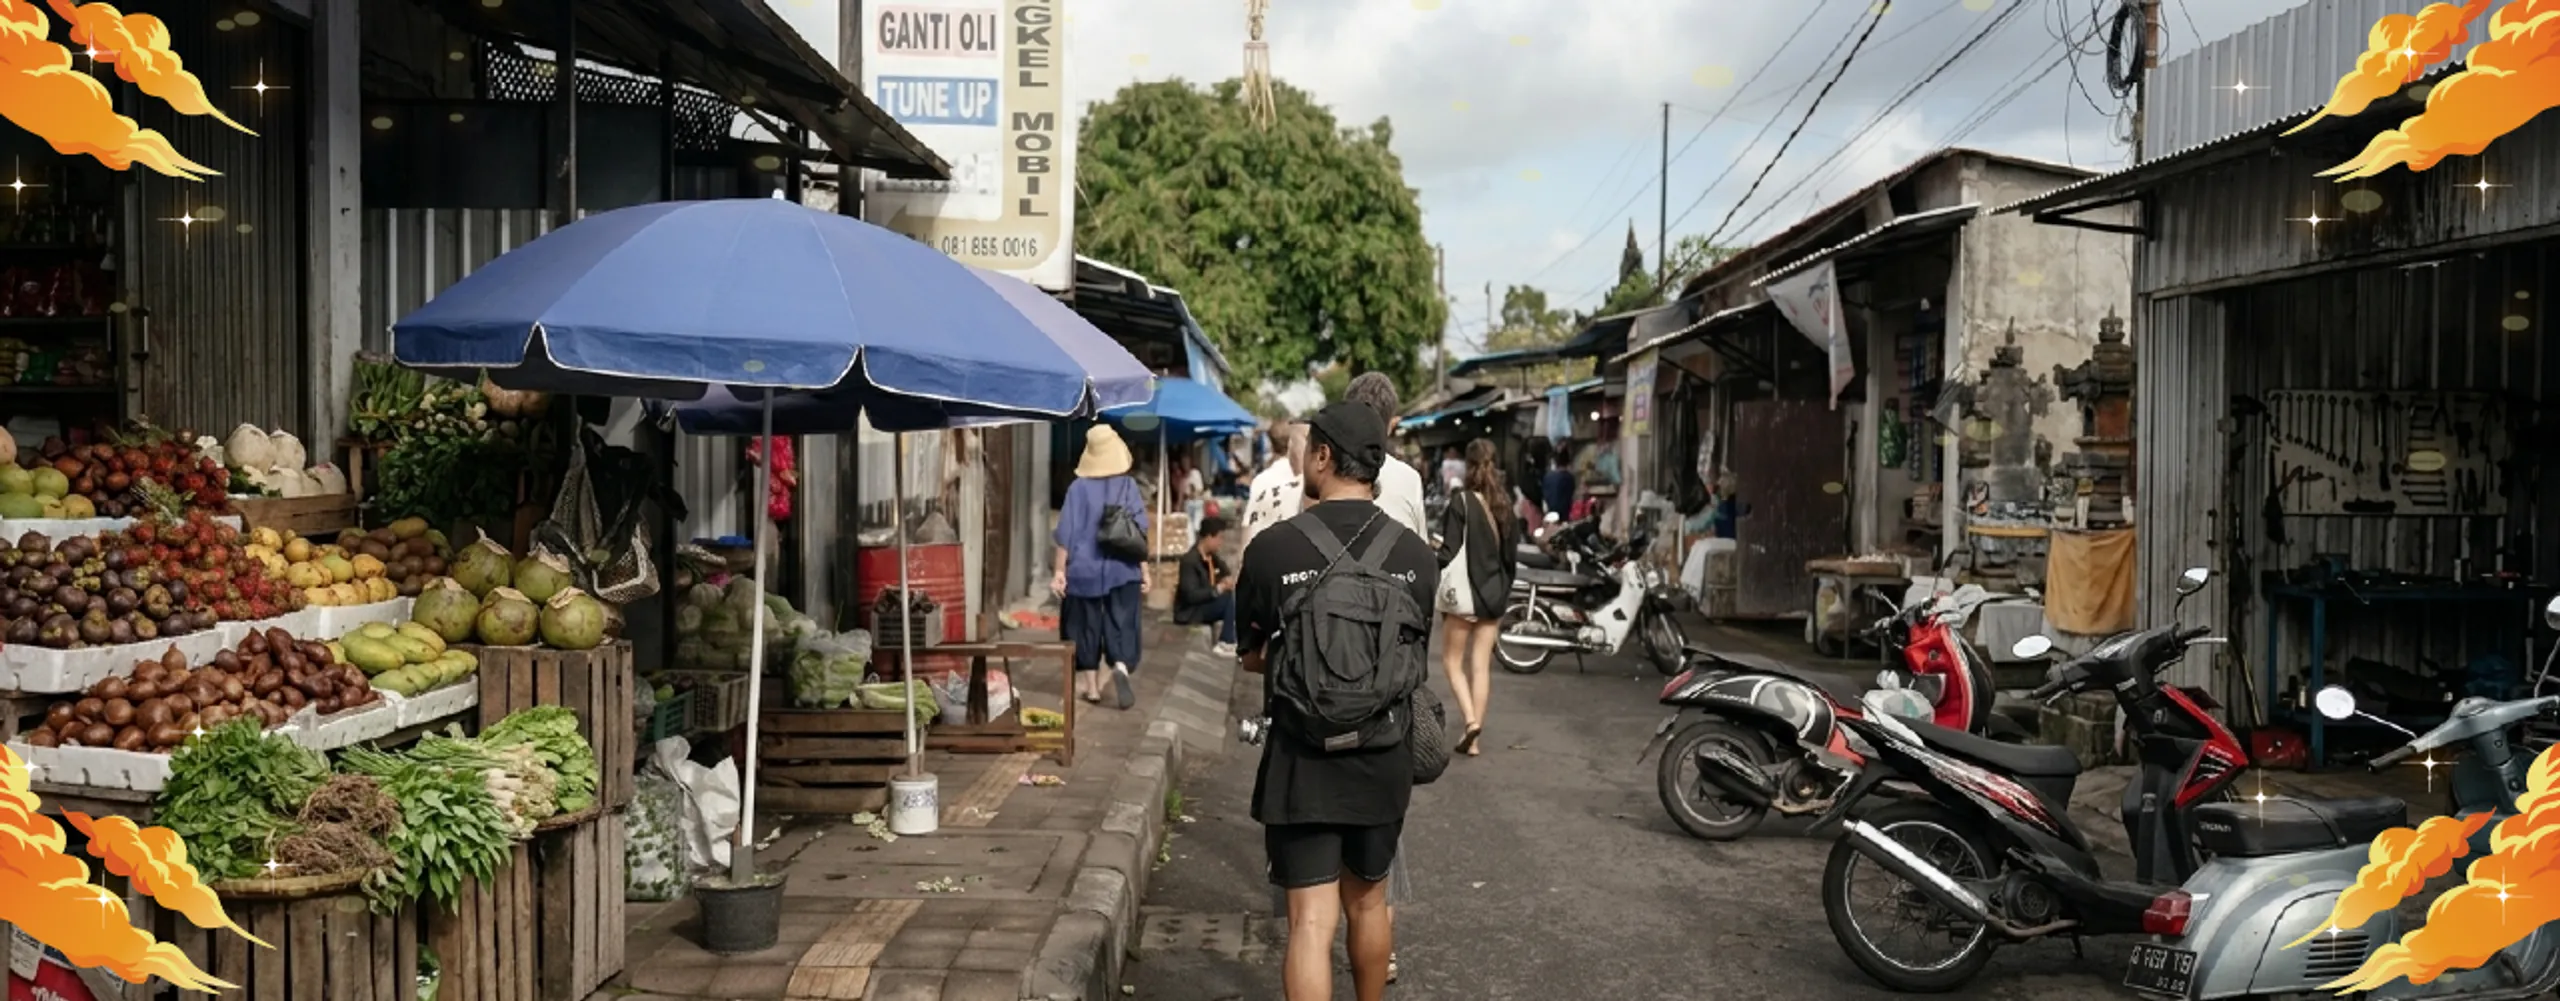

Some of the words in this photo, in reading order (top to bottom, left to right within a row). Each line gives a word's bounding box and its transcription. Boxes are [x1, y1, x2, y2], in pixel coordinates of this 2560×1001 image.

[879, 11, 950, 50] GANTI
[959, 13, 996, 51] OLI
[1014, 0, 1052, 87] GKEL
[881, 81, 949, 118] TUNE
[957, 82, 992, 119] UP
[1012, 112, 1054, 217] MOBIL
[941, 235, 967, 255] 081
[1002, 237, 1038, 258] 0016
